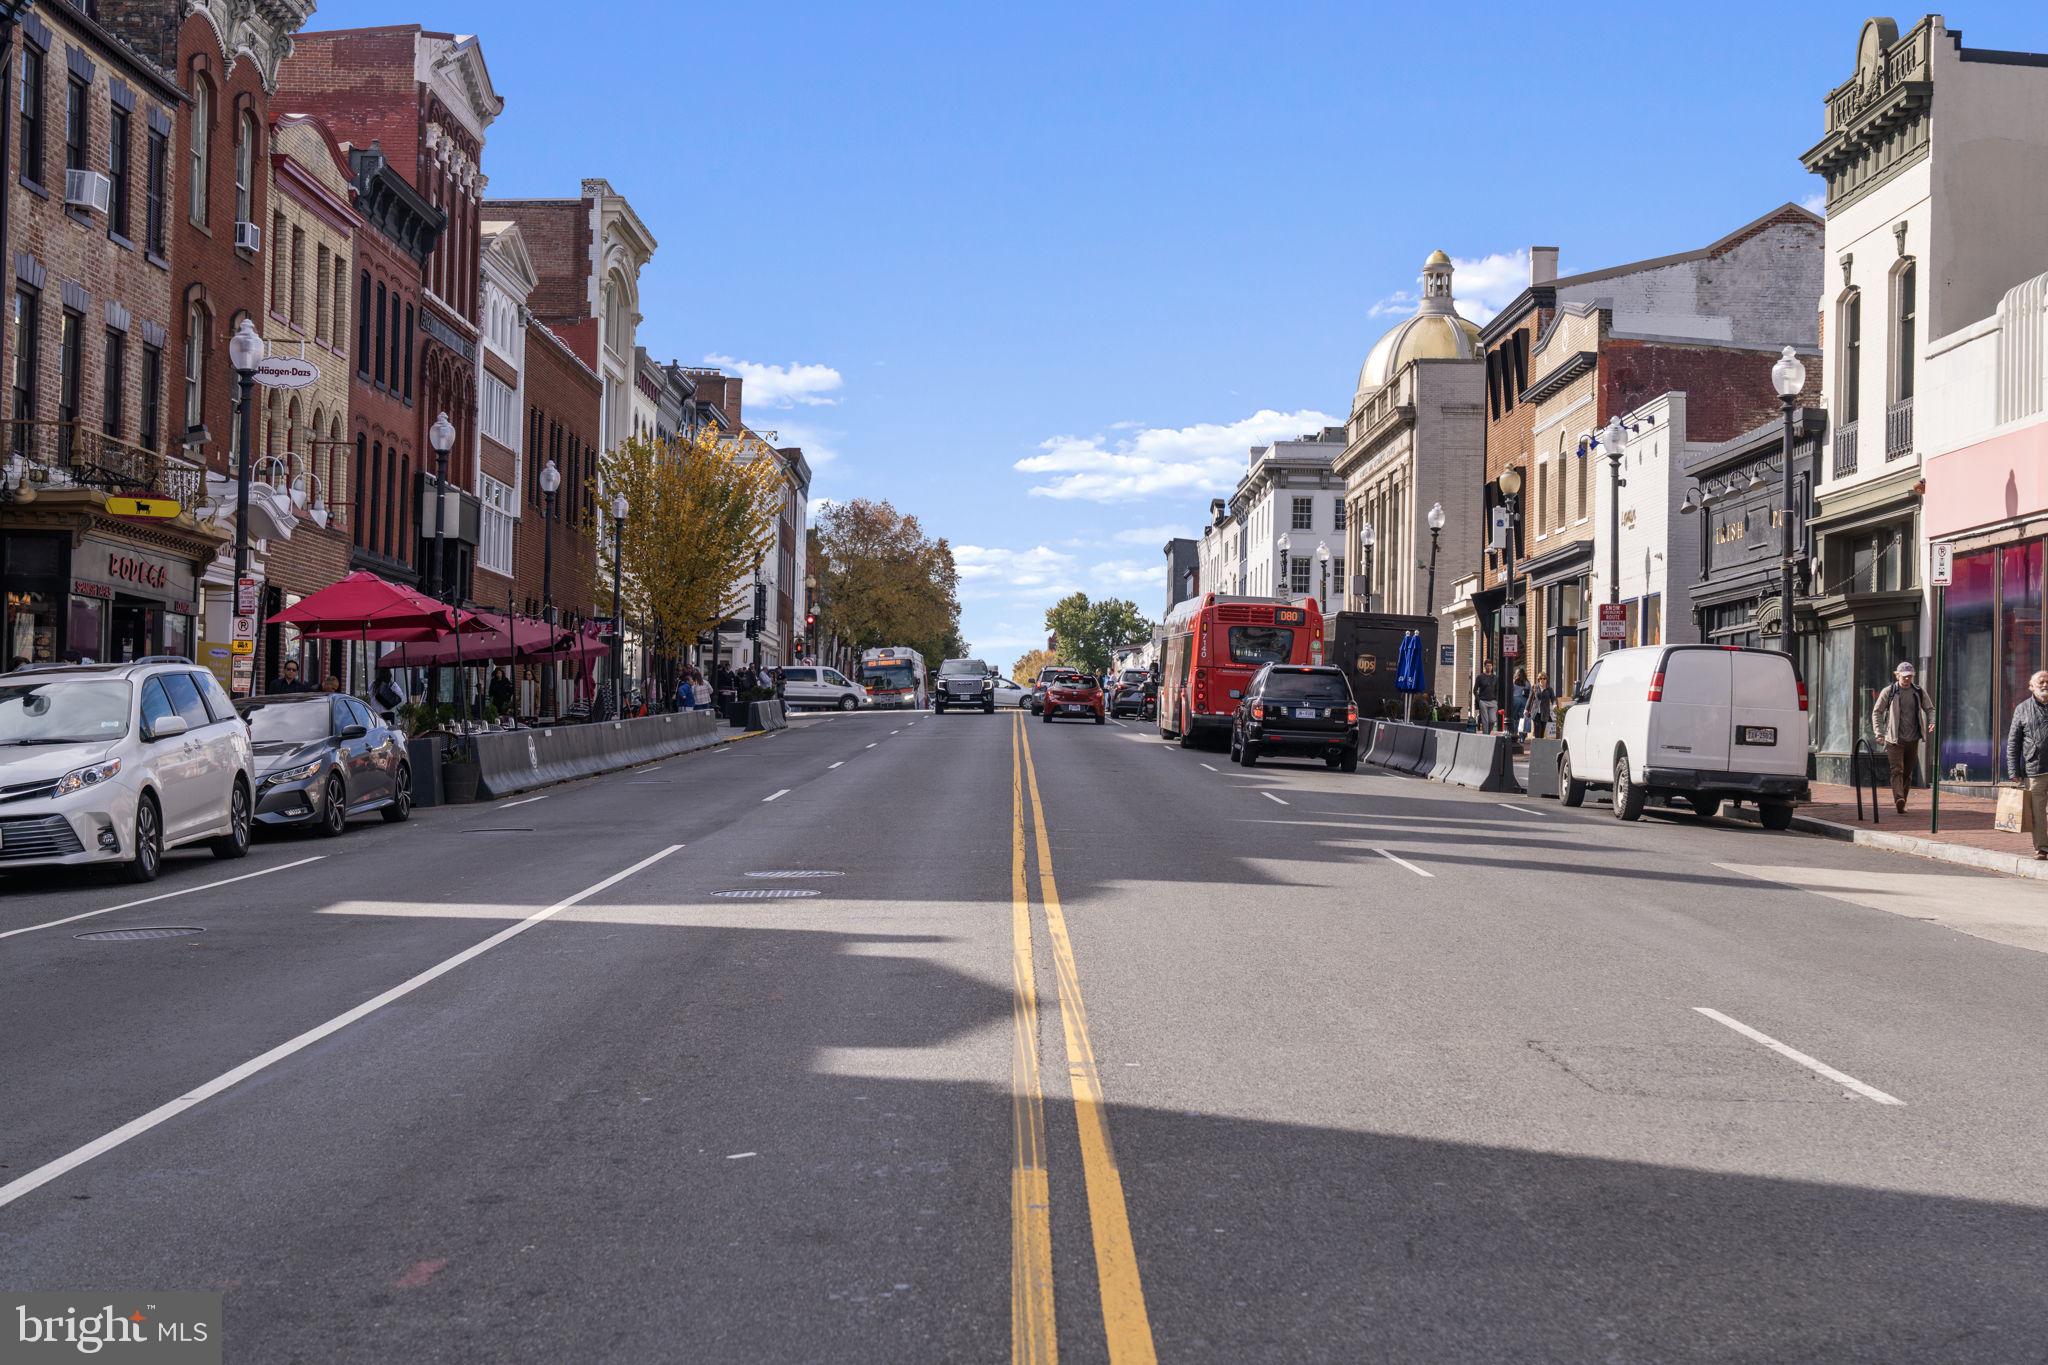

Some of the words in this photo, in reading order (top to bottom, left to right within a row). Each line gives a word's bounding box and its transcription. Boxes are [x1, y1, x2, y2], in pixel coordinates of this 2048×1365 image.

[1716, 521, 1743, 545] IRISH
[109, 553, 167, 588] BODEGA
[1359, 661, 1375, 673] ups
